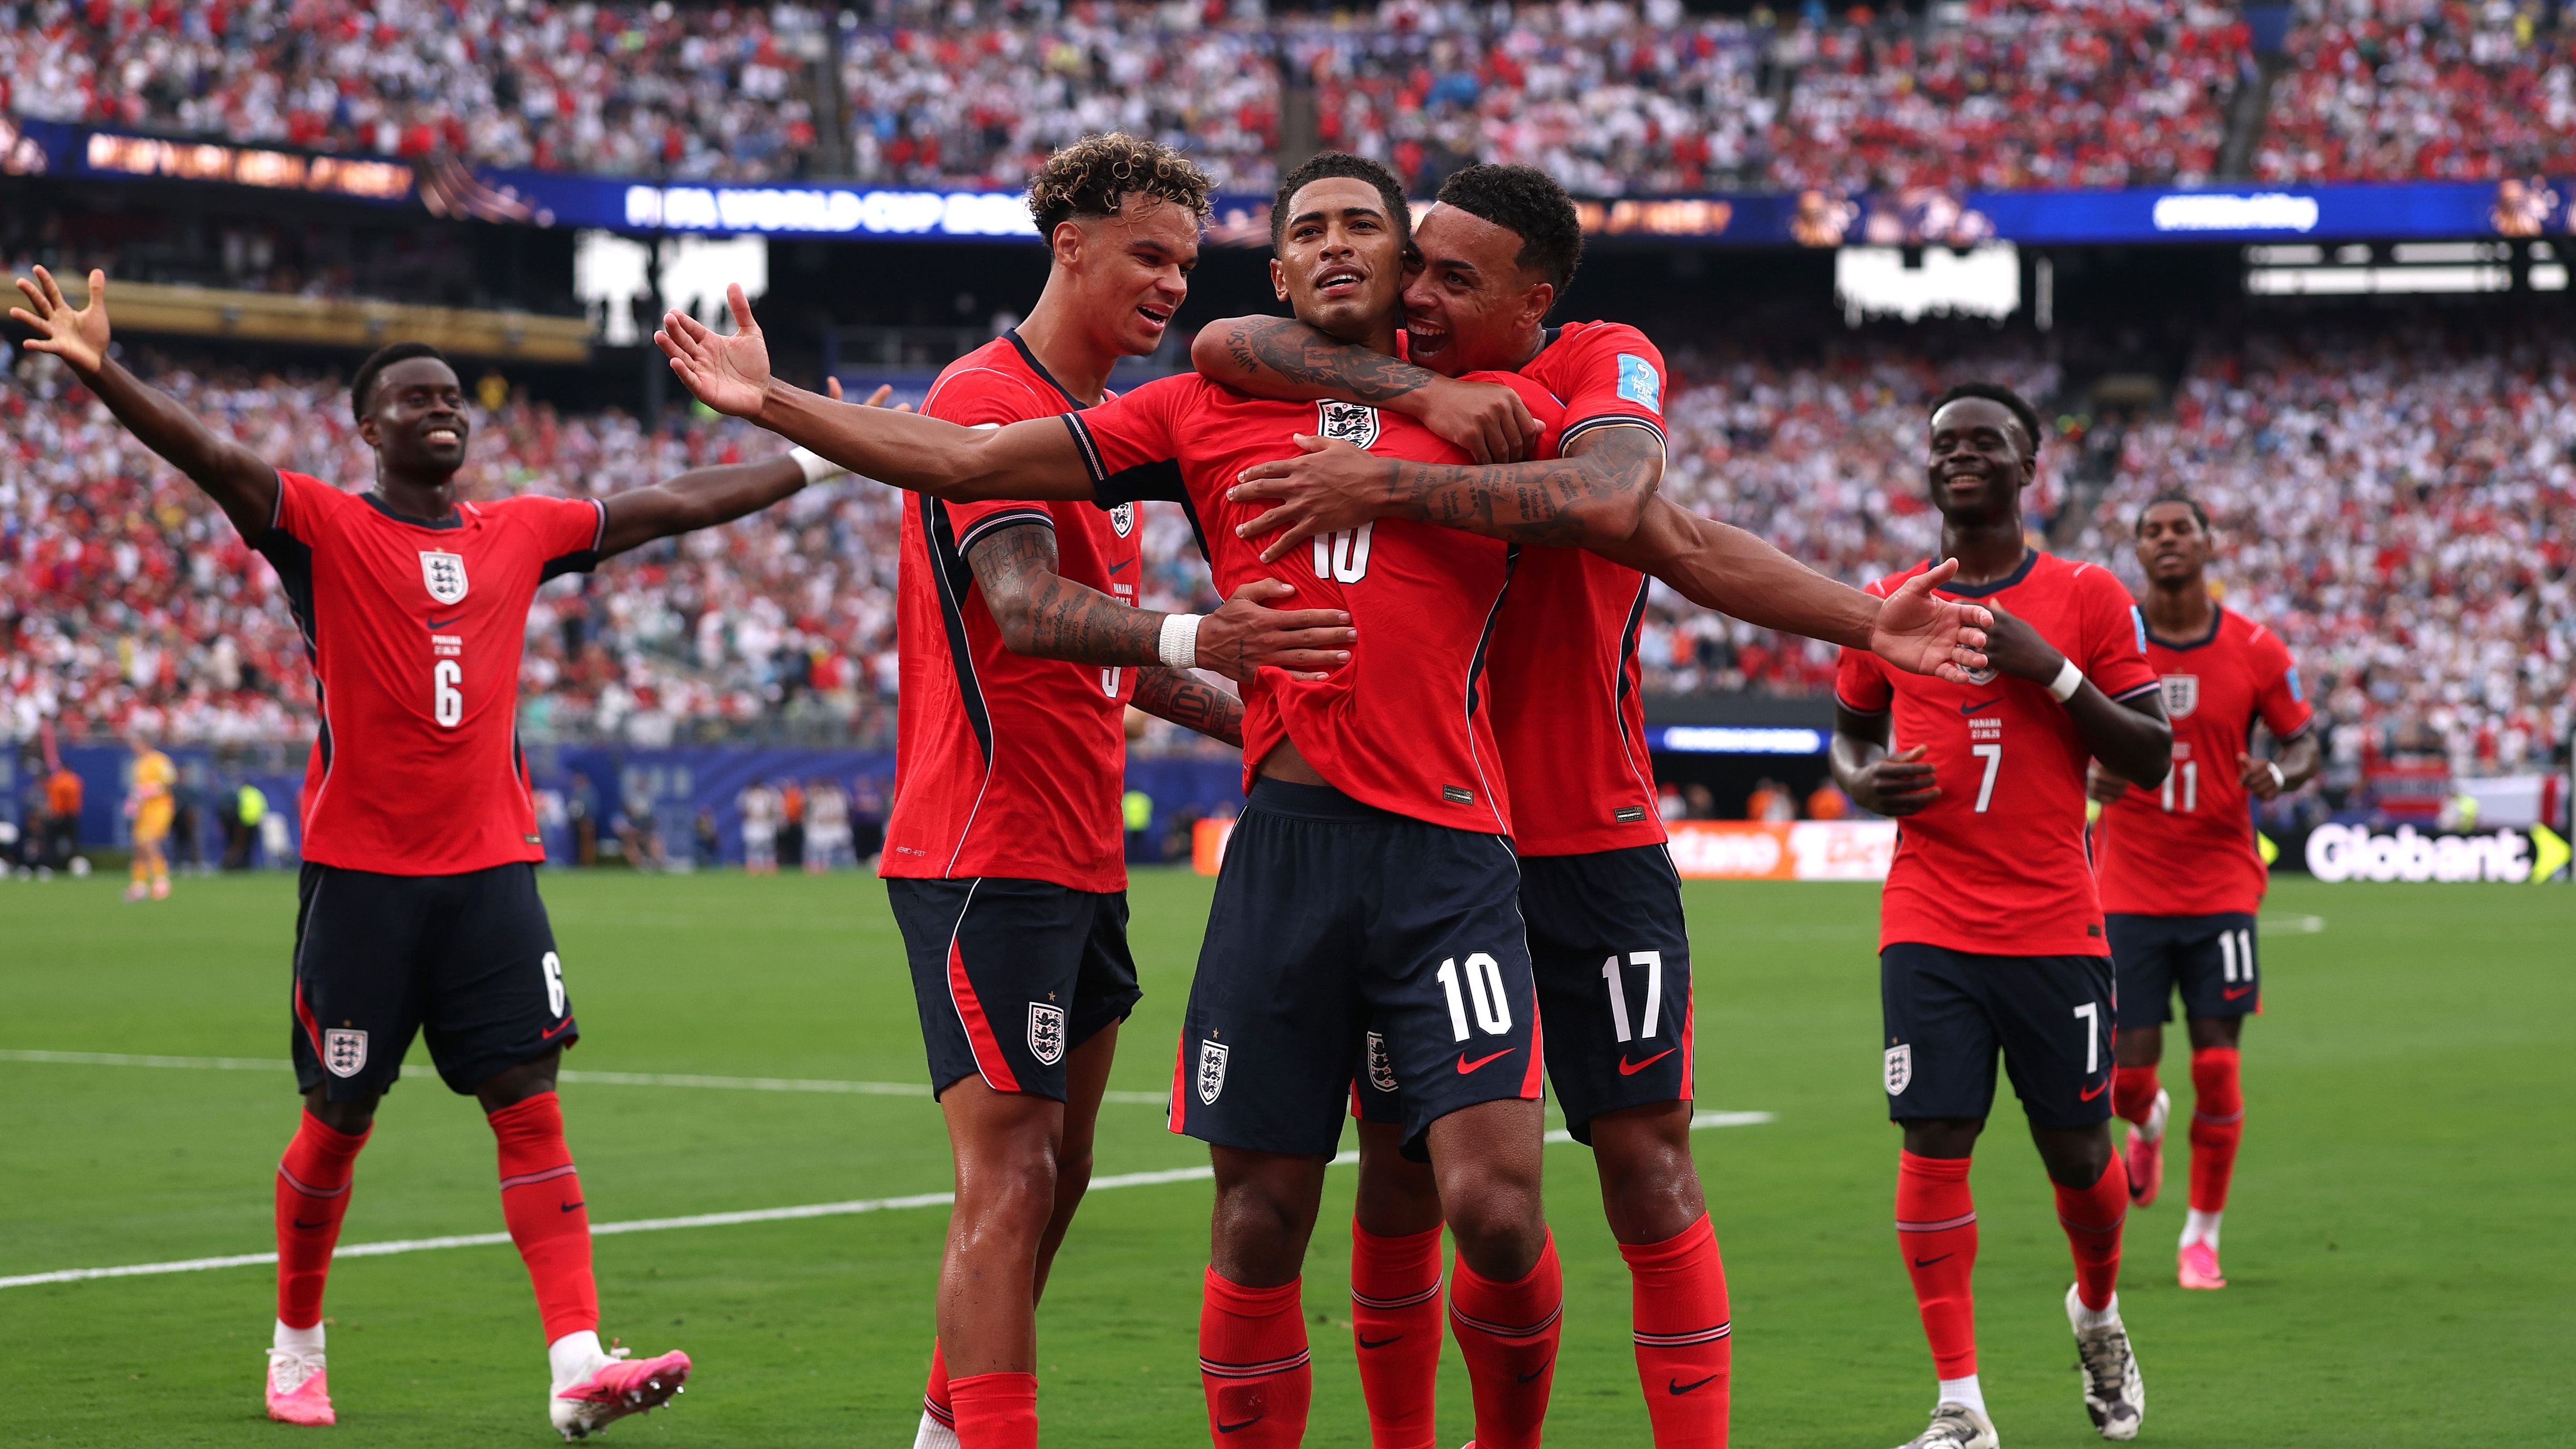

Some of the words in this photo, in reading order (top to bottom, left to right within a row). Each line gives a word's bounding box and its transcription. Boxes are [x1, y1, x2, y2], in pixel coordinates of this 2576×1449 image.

[1633, 384, 1653, 401] PEACE
[1113, 583, 1133, 595] PANAMA
[434, 659, 463, 727] 6
[1968, 718, 2002, 729] PANAMA
[1972, 743, 2002, 813] 7
[2305, 823, 2533, 883] Globant
[541, 951, 565, 1019] 6
[2218, 928, 2255, 983] 11
[1435, 951, 1514, 1044] 10
[1602, 950, 1663, 1043] 17
[2073, 1001, 2098, 1075] 7
